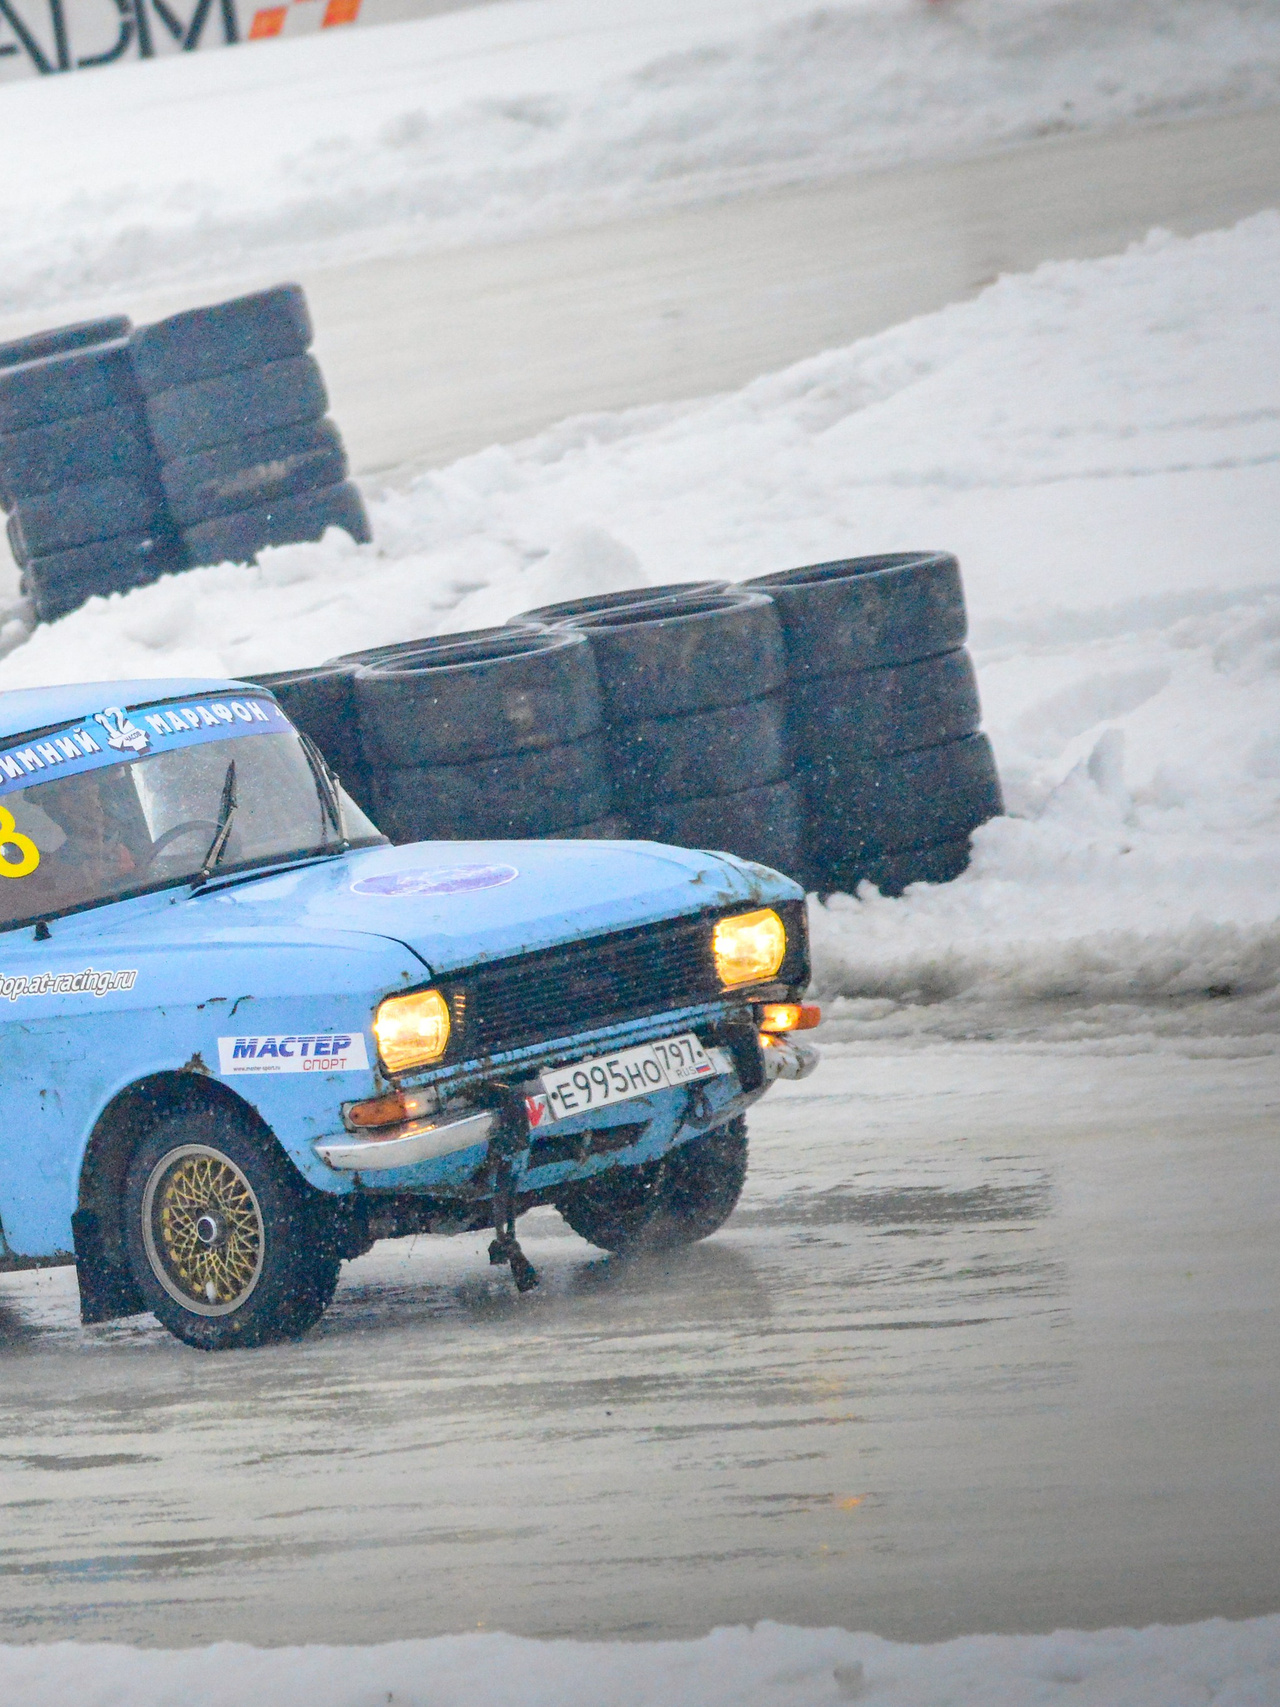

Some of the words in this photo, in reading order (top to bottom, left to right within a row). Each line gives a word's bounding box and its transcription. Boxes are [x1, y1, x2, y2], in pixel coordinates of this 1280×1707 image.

[94, 706, 136, 739] 12
[144, 701, 270, 736] МАРАФОН
[232, 1035, 352, 1059] МАСТЕР
[654, 1039, 697, 1071] 797
[303, 1058, 348, 1071] СПОРТ
[676, 1063, 697, 1079] RUS
